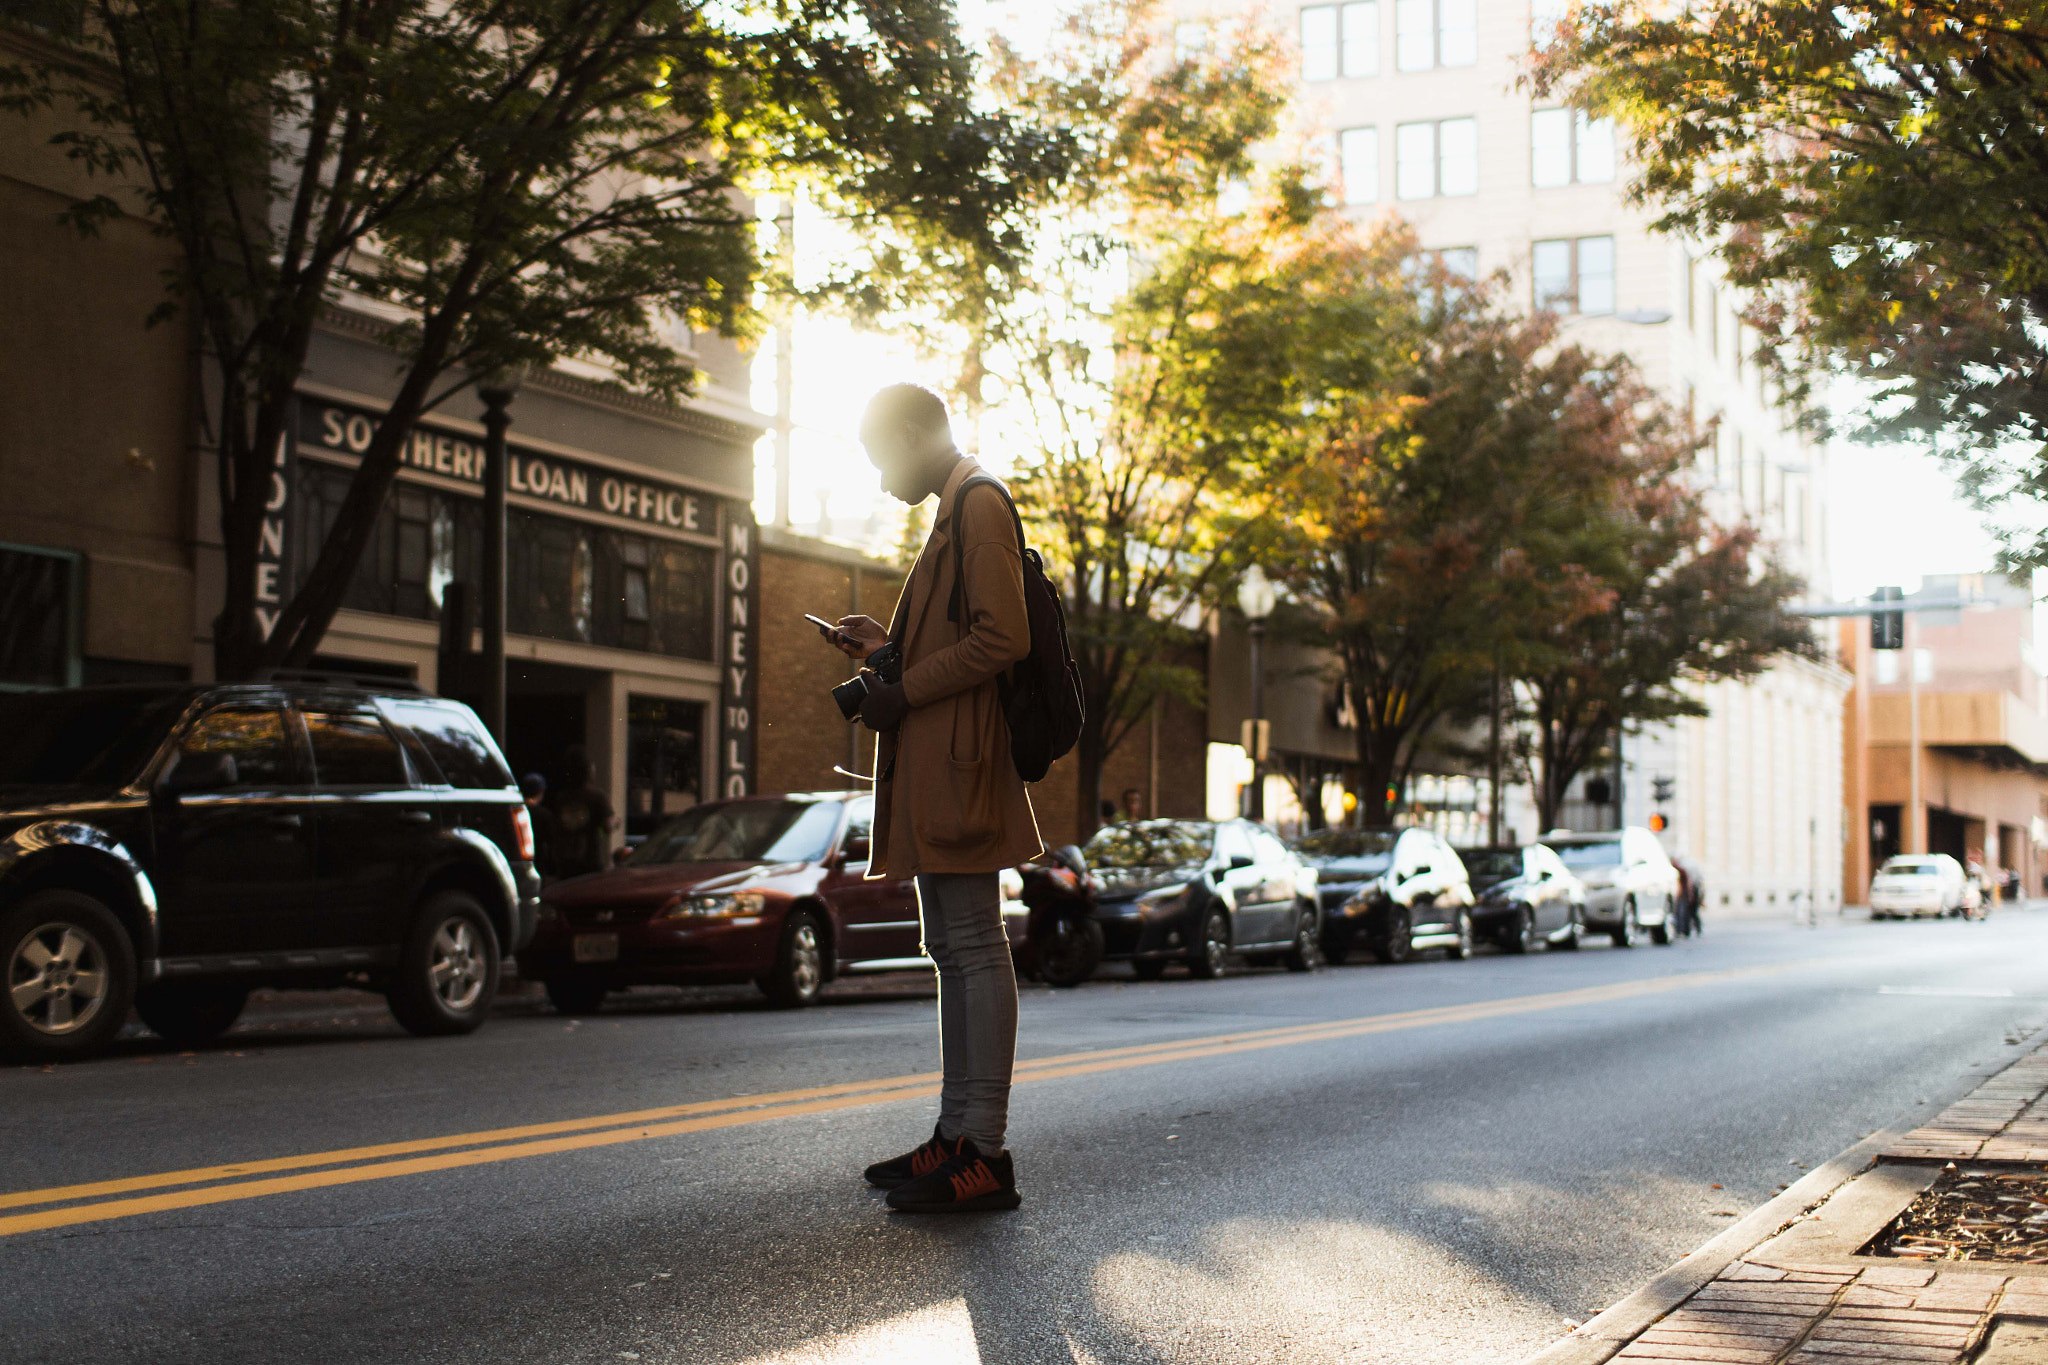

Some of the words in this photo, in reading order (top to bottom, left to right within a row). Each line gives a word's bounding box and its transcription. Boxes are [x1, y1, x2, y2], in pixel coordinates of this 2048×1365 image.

[322, 407, 487, 481] SOHERN
[509, 455, 588, 506] LOAN
[601, 477, 699, 530] OFFICE
[730, 523, 749, 697] MONEY
[727, 706, 749, 731] TO
